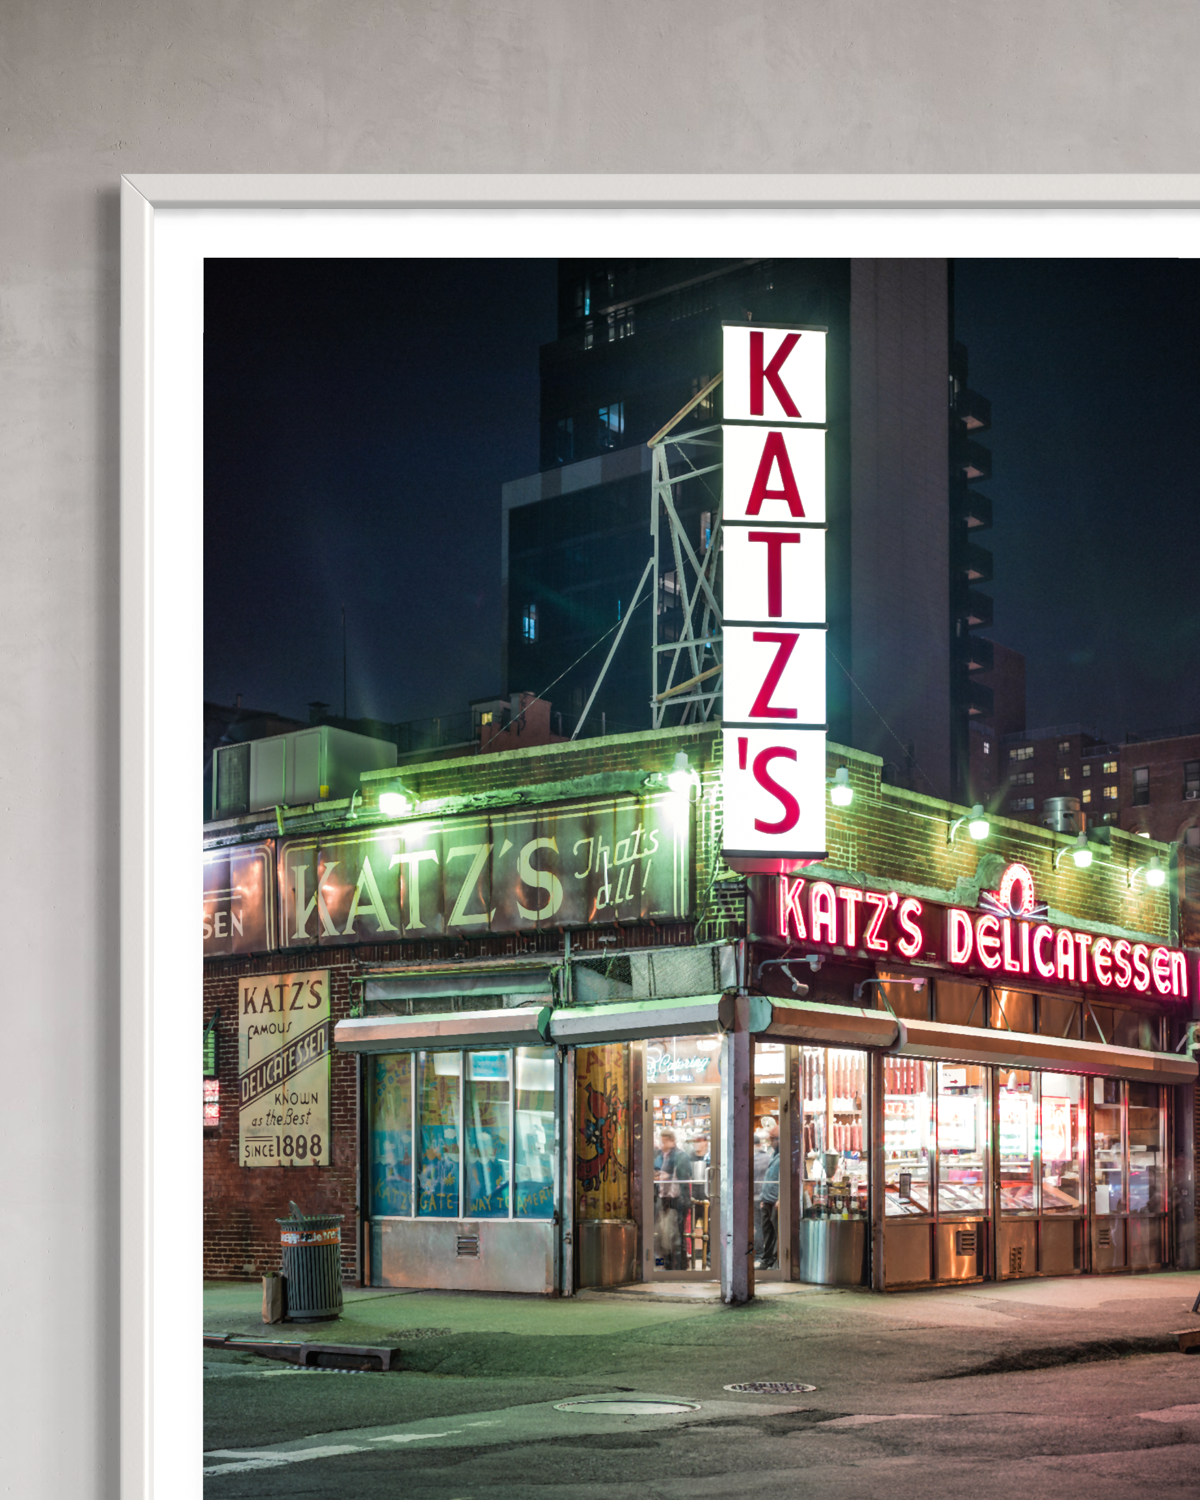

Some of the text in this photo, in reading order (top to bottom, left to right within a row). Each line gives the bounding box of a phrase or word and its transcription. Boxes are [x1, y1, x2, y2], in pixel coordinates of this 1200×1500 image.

[737, 331, 805, 835] KATZ'S
[573, 823, 659, 879] That's
[291, 836, 563, 939] KATZ'S
[596, 859, 651, 909] all!
[779, 875, 1188, 997] KATZ'S DELICATESSEN
[243, 979, 323, 1014] KATZ'S
[241, 1027, 325, 1103] DELICATESSEN
[659, 1053, 711, 1073] Catering
[252, 1108, 312, 1127] as the Best
[275, 1090, 318, 1105] KNOWN
[244, 1144, 275, 1158] SINCE
[420, 1191, 454, 1212] GATE
[470, 1194, 492, 1212] WAY
